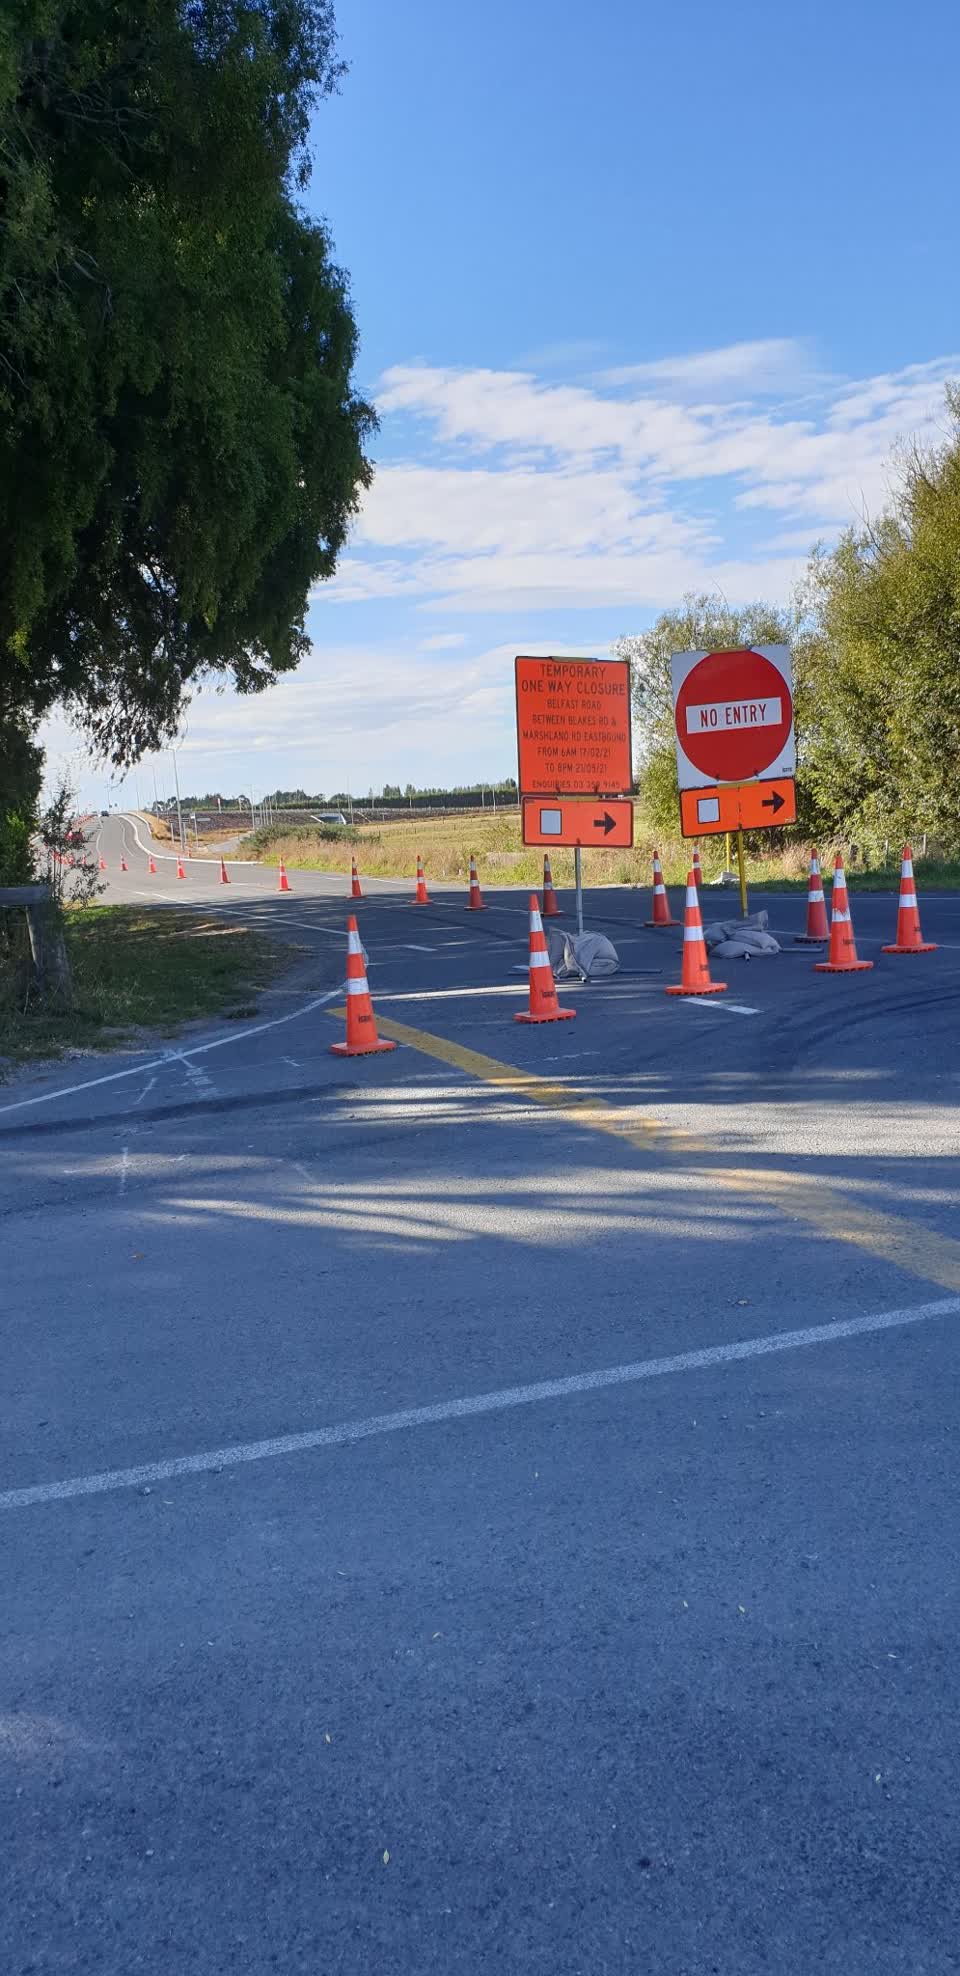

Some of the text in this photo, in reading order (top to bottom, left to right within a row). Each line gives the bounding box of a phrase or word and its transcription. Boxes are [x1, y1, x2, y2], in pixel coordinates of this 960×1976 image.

[540, 663, 606, 679] TEMPORARY
[521, 679, 625, 696] ONE WAY CLOSURE
[547, 698, 602, 711] BELFAST ROAD
[532, 714, 566, 725] BETWEEN
[599, 717, 609, 727] RD
[700, 703, 767, 728] NO ENTRY
[522, 729, 626, 743] MARSHLAND RD EASTBOUND
[537, 746, 558, 758] FROM
[561, 747, 577, 758] 6AM
[545, 762, 555, 773] TO
